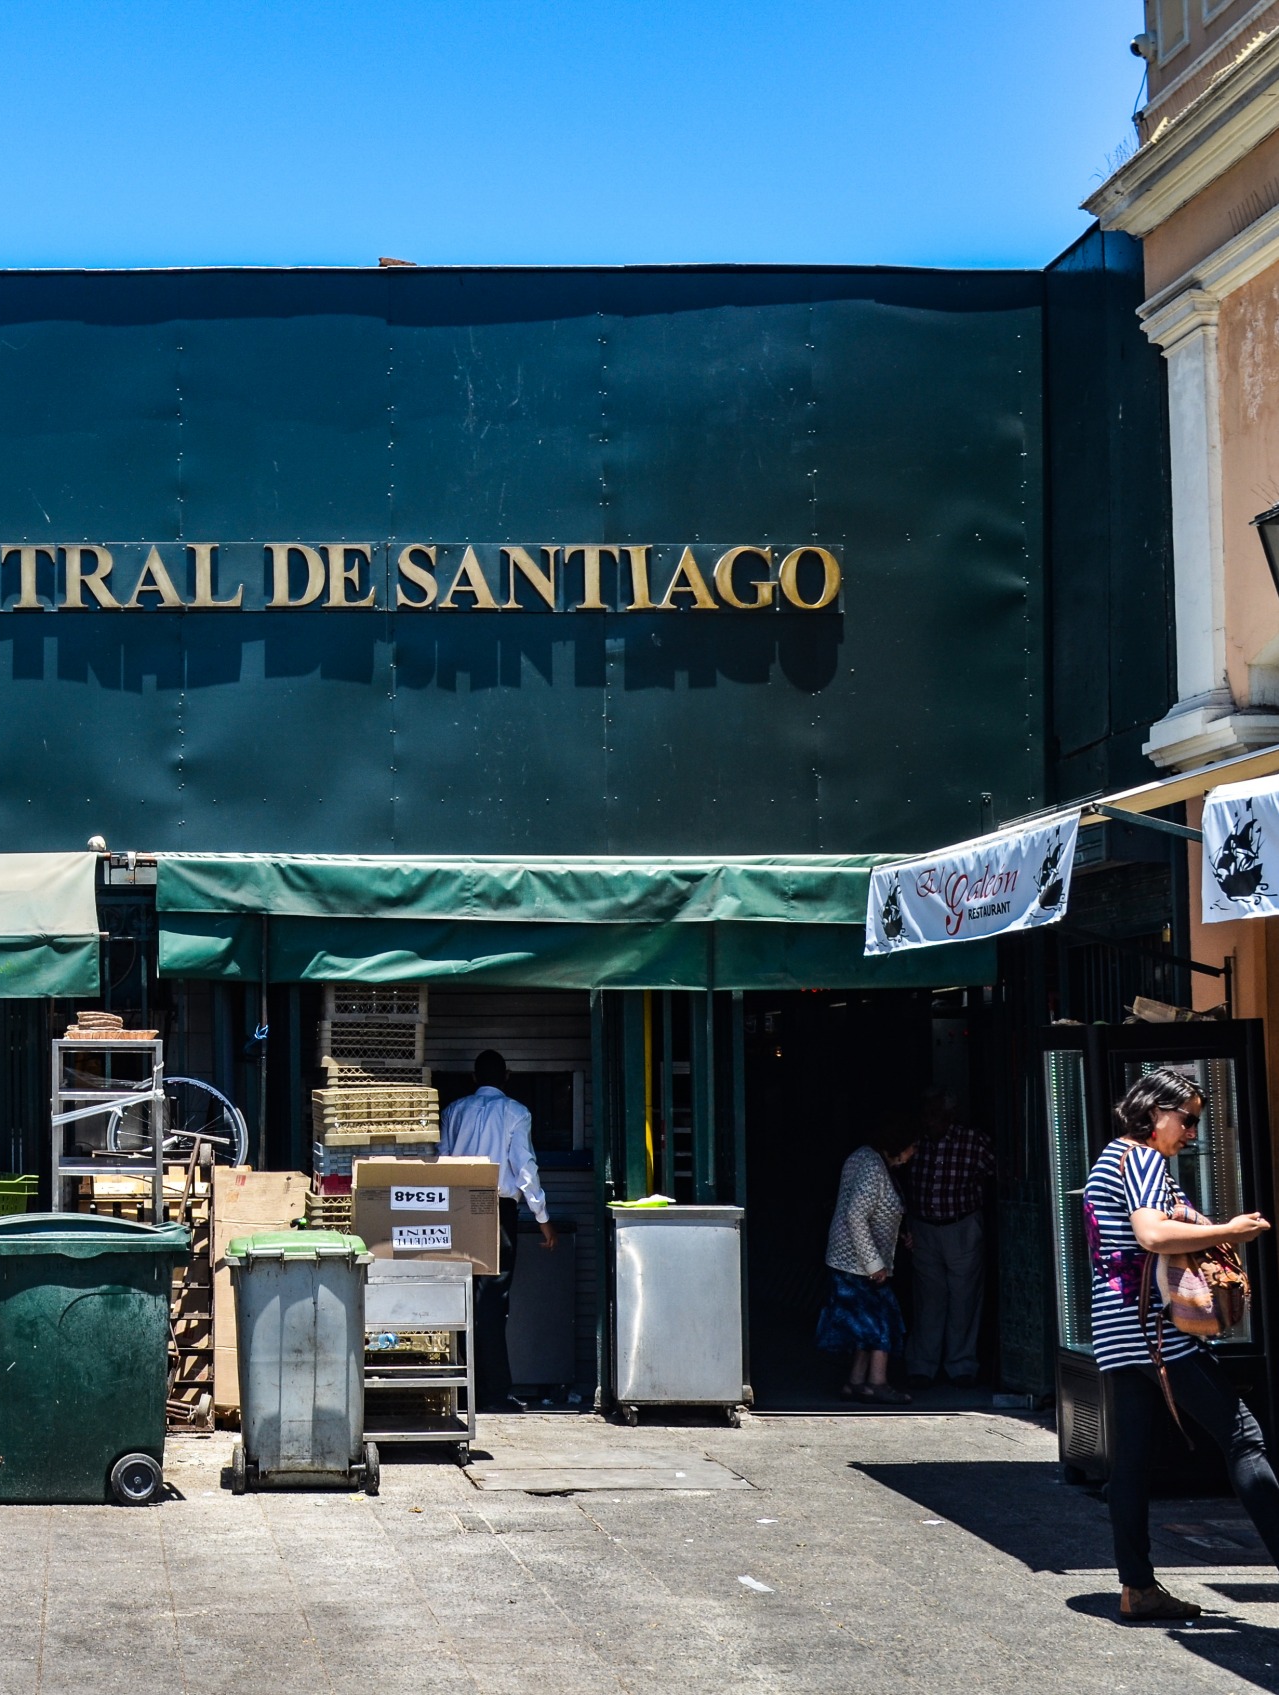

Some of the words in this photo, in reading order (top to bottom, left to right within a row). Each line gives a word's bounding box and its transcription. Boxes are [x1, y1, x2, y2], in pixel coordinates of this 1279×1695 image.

[264, 544, 375, 609] DE
[396, 545, 841, 610] SANTIAGO
[915, 866, 946, 898] El
[945, 864, 1019, 936] Galeón
[968, 901, 1011, 920] RESTAURANT
[395, 1191, 446, 1203] 15348
[399, 1228, 447, 1236] MINI
